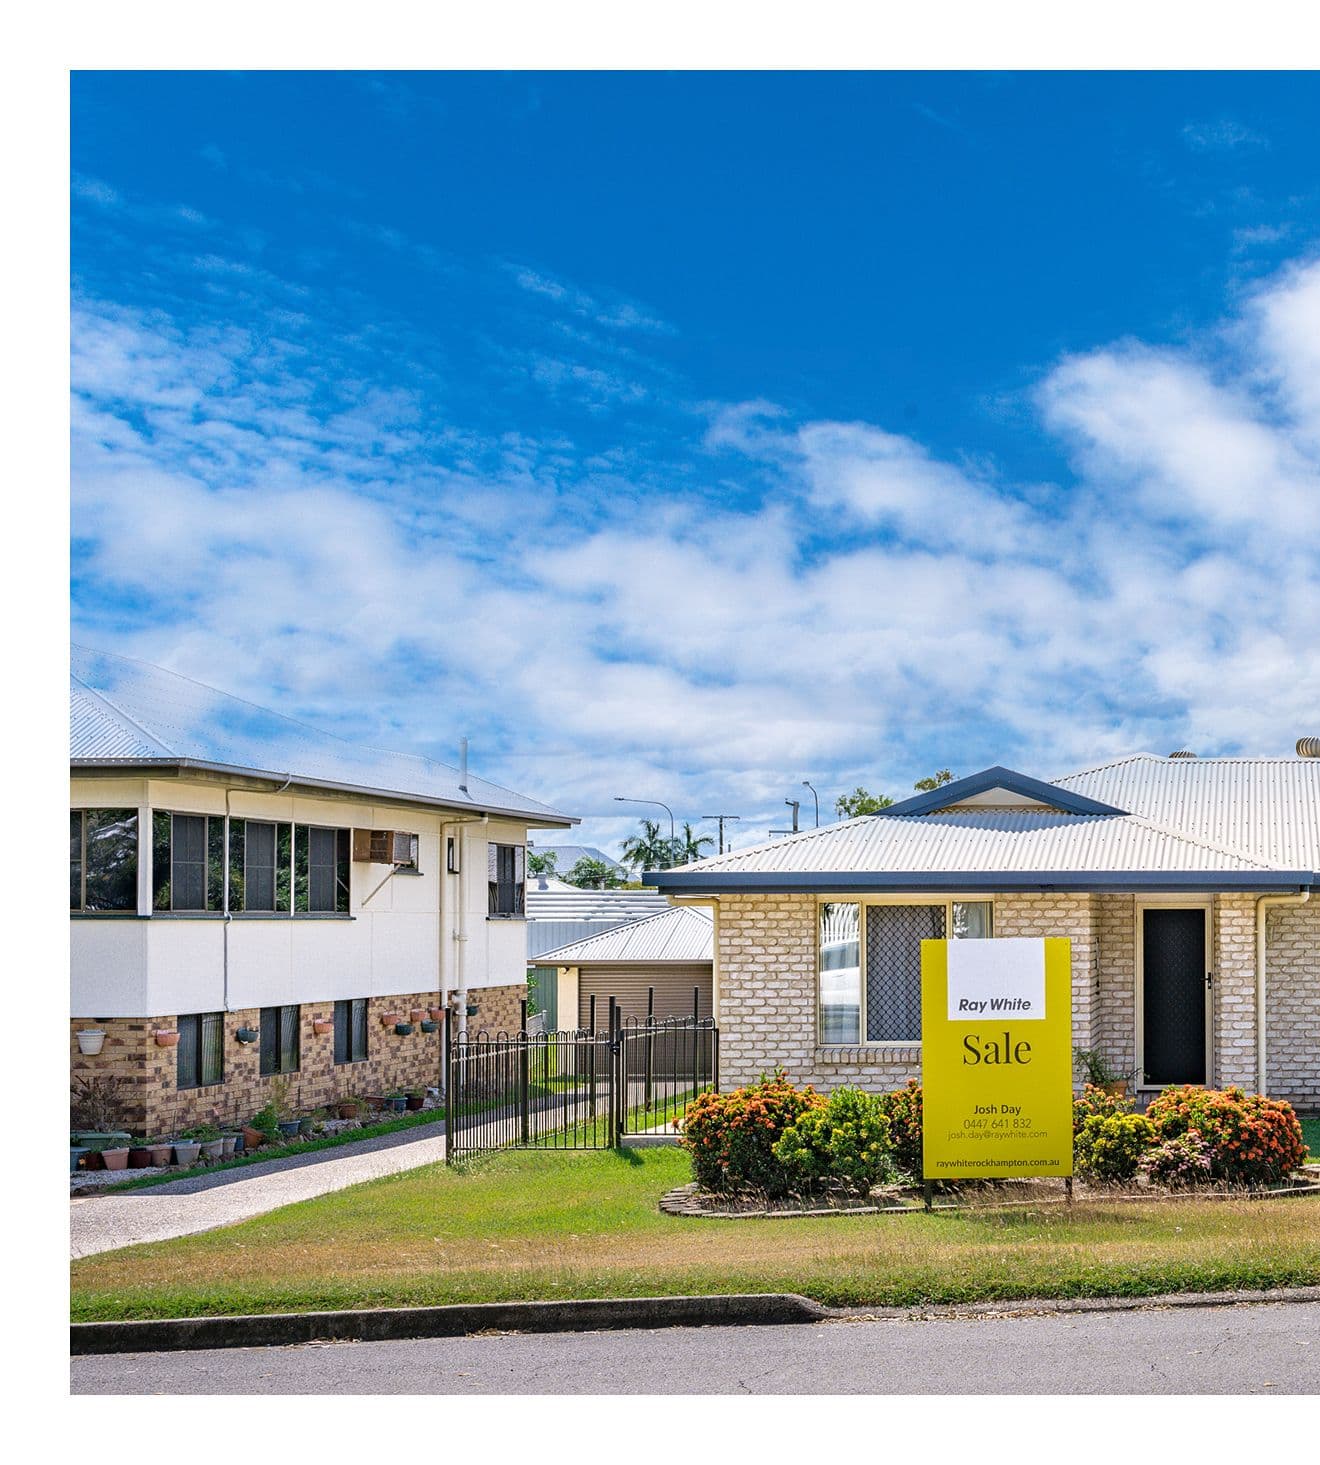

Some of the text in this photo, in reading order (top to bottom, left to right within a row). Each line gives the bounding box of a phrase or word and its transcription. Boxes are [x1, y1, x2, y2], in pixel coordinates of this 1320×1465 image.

[959, 998, 1031, 1013] Ray White
[963, 1031, 1032, 1065] Sale
[974, 1105, 1021, 1116] Josh Day
[963, 1119, 1032, 1129] 0447 641 832
[948, 1130, 1048, 1140] josh.day@raywhite.com
[936, 1159, 1060, 1168] raywhiterockhampton.com.au
